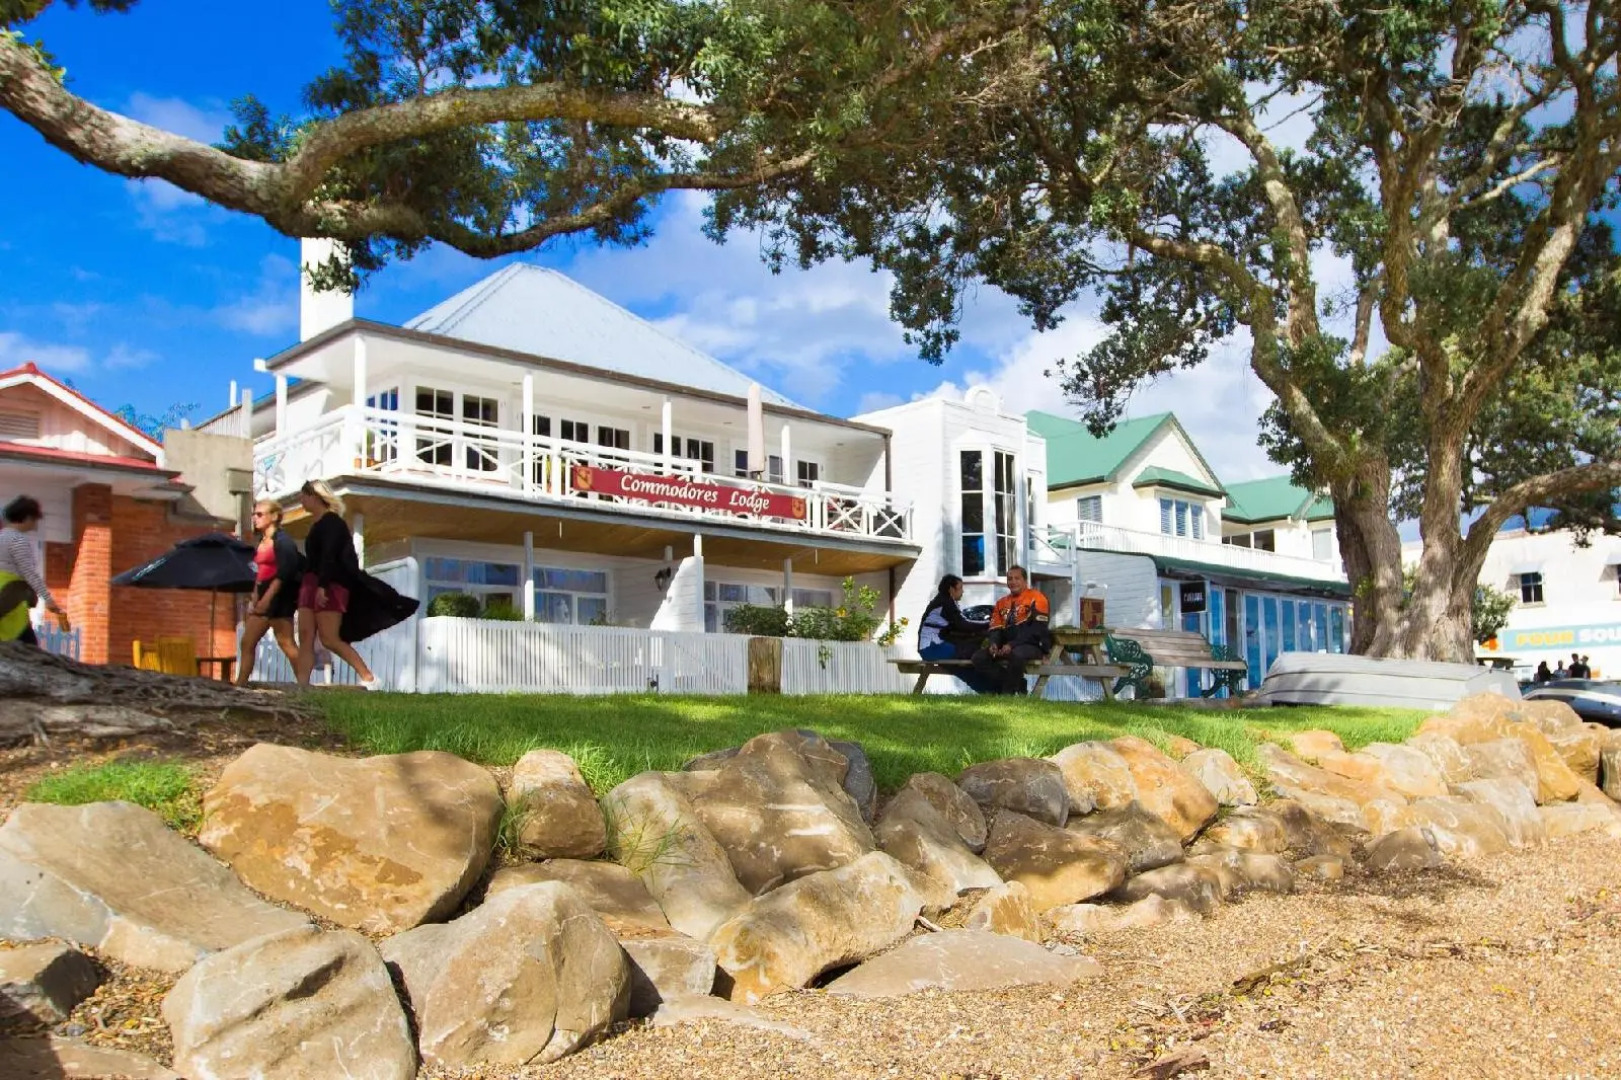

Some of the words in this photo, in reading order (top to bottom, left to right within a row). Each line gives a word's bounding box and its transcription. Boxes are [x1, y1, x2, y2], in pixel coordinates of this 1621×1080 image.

[620, 474, 718, 503] Commodores
[729, 491, 770, 512] Lodge
[1517, 631, 1574, 646] FOUR
